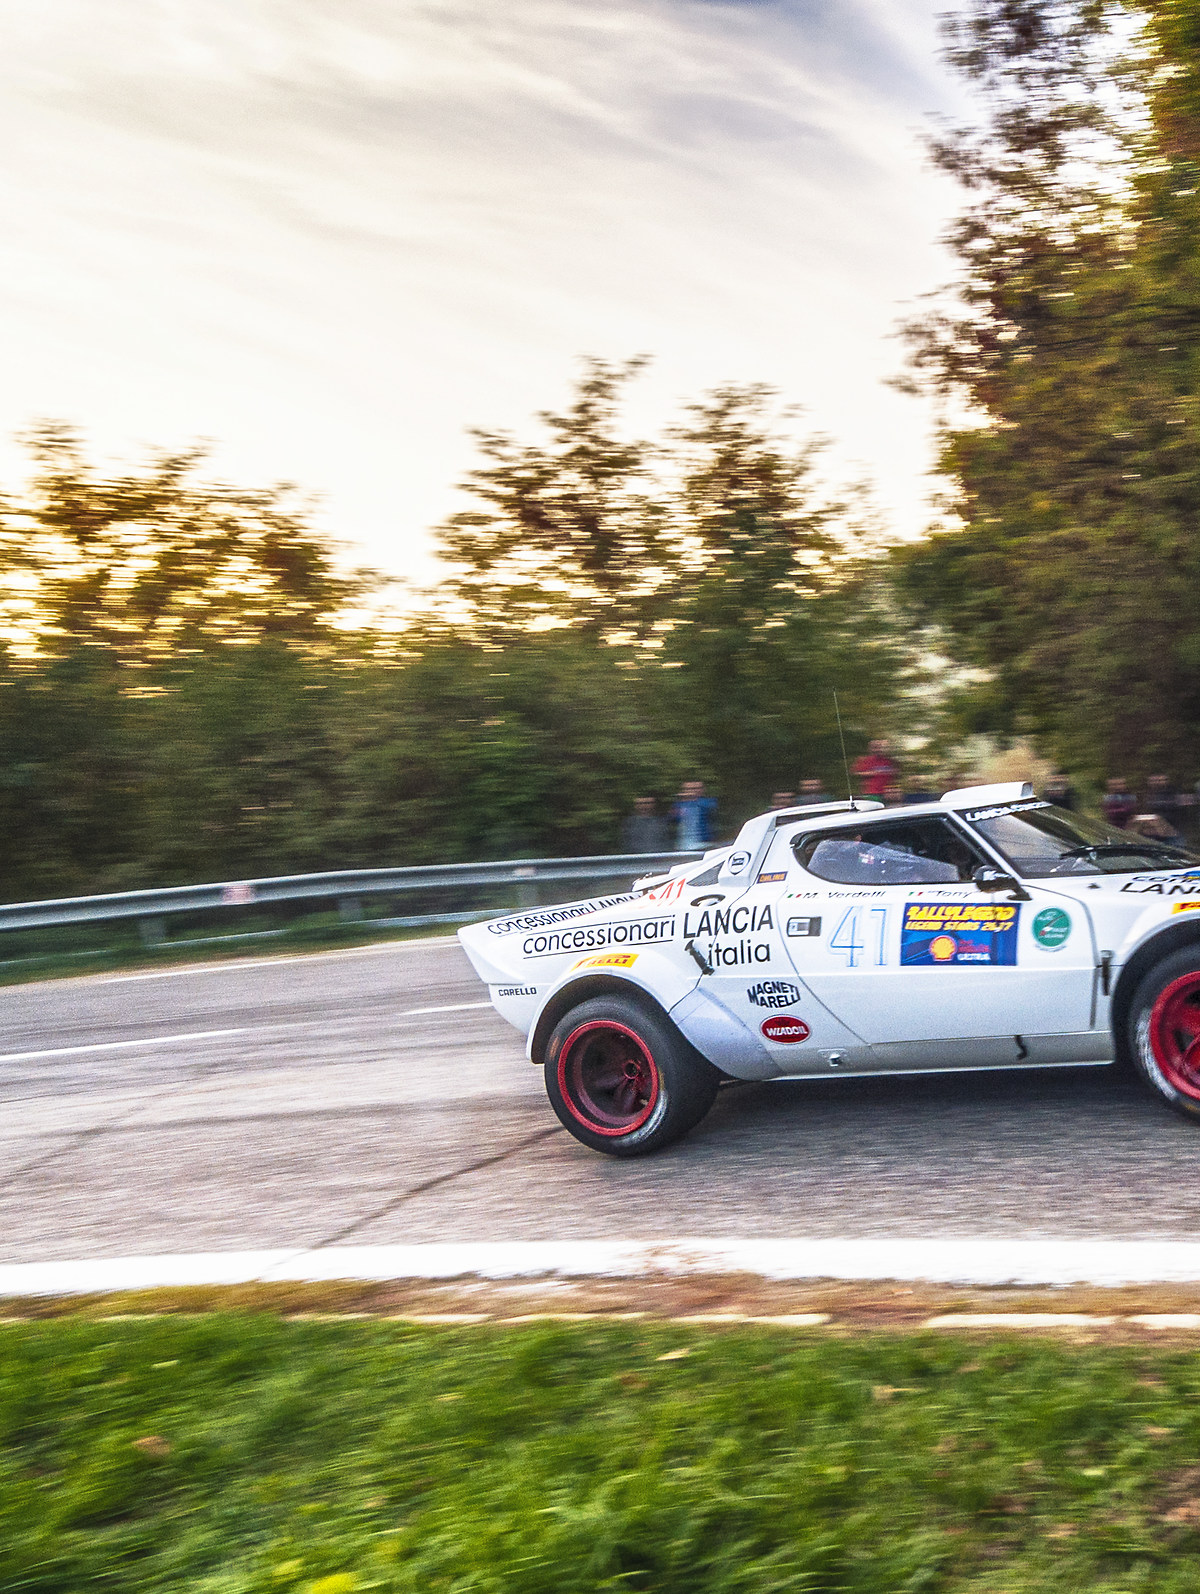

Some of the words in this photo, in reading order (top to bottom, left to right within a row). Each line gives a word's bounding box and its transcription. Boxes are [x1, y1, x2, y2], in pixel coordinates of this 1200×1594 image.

[523, 914, 676, 954] concessionari
[684, 904, 774, 939] LANCIA
[826, 902, 892, 968] 41
[707, 939, 771, 967] italia
[498, 986, 537, 997] CARELLO
